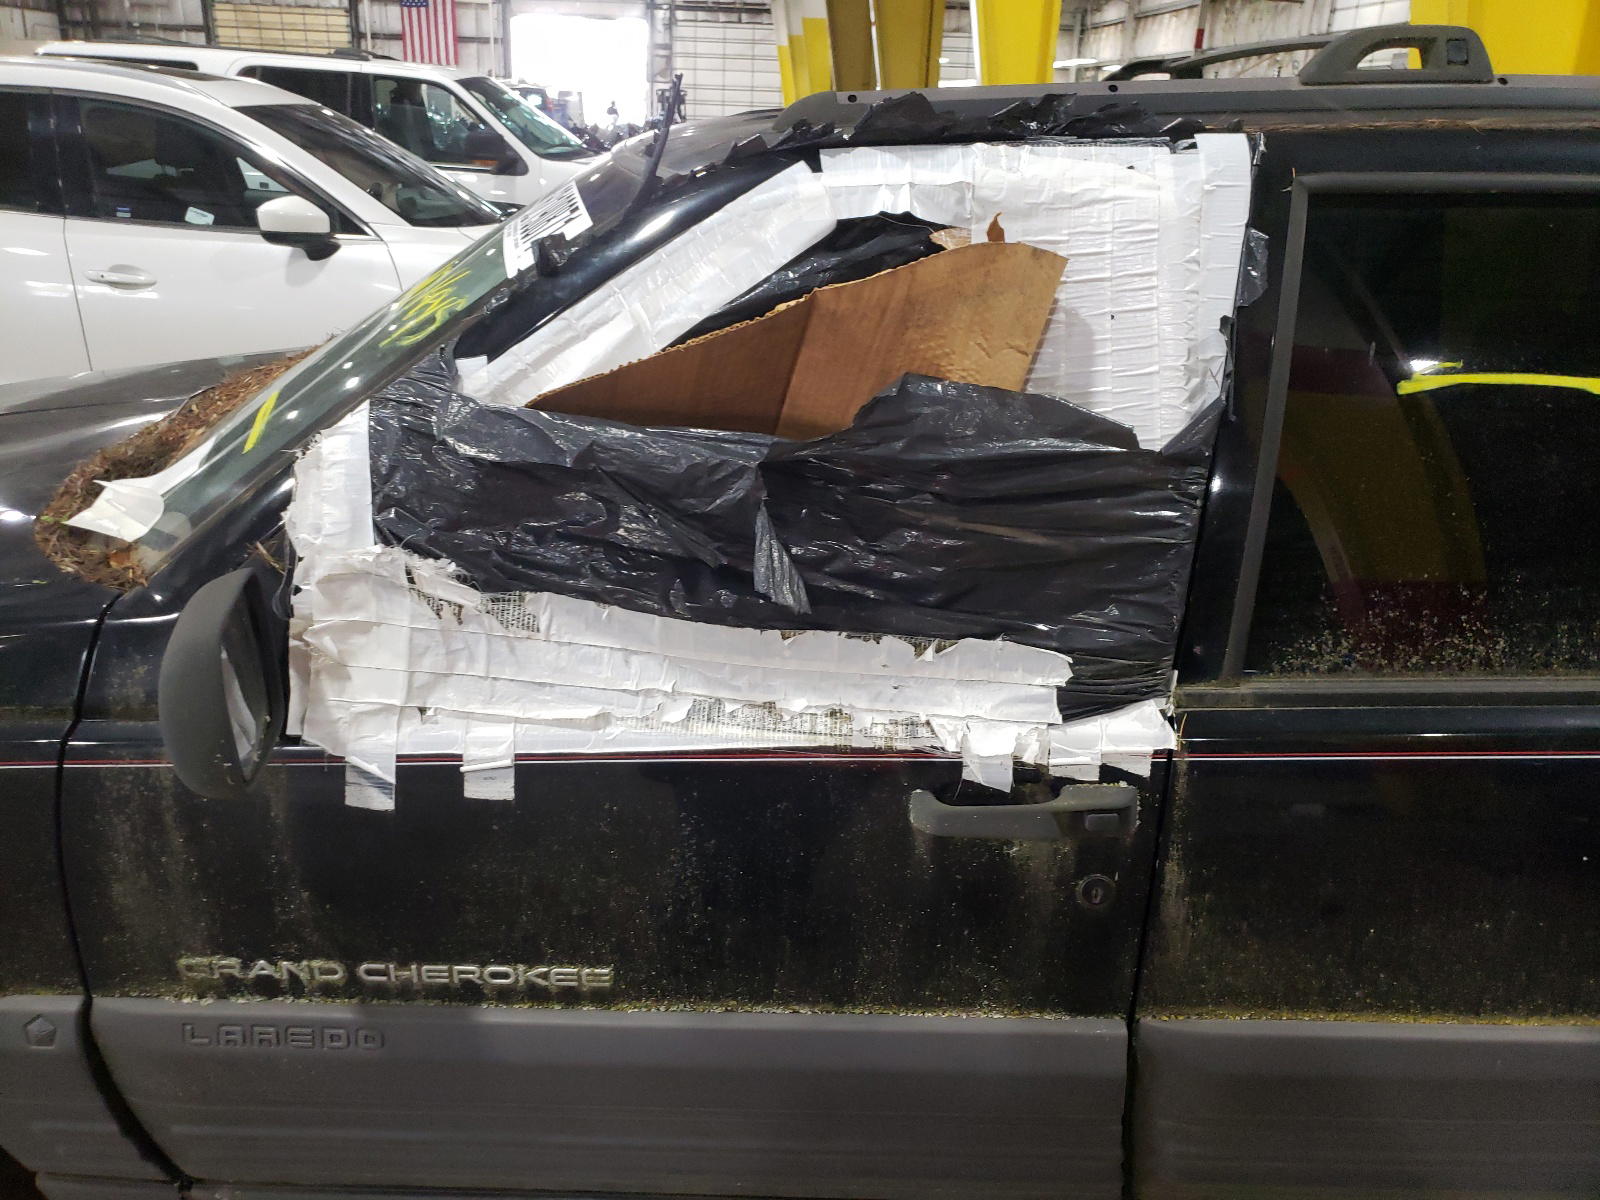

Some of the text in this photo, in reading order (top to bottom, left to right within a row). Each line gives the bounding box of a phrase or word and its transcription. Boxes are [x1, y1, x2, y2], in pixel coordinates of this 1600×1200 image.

[177, 957, 615, 987] GRAND CHEROKEE
[182, 1022, 385, 1050] LAREDO
